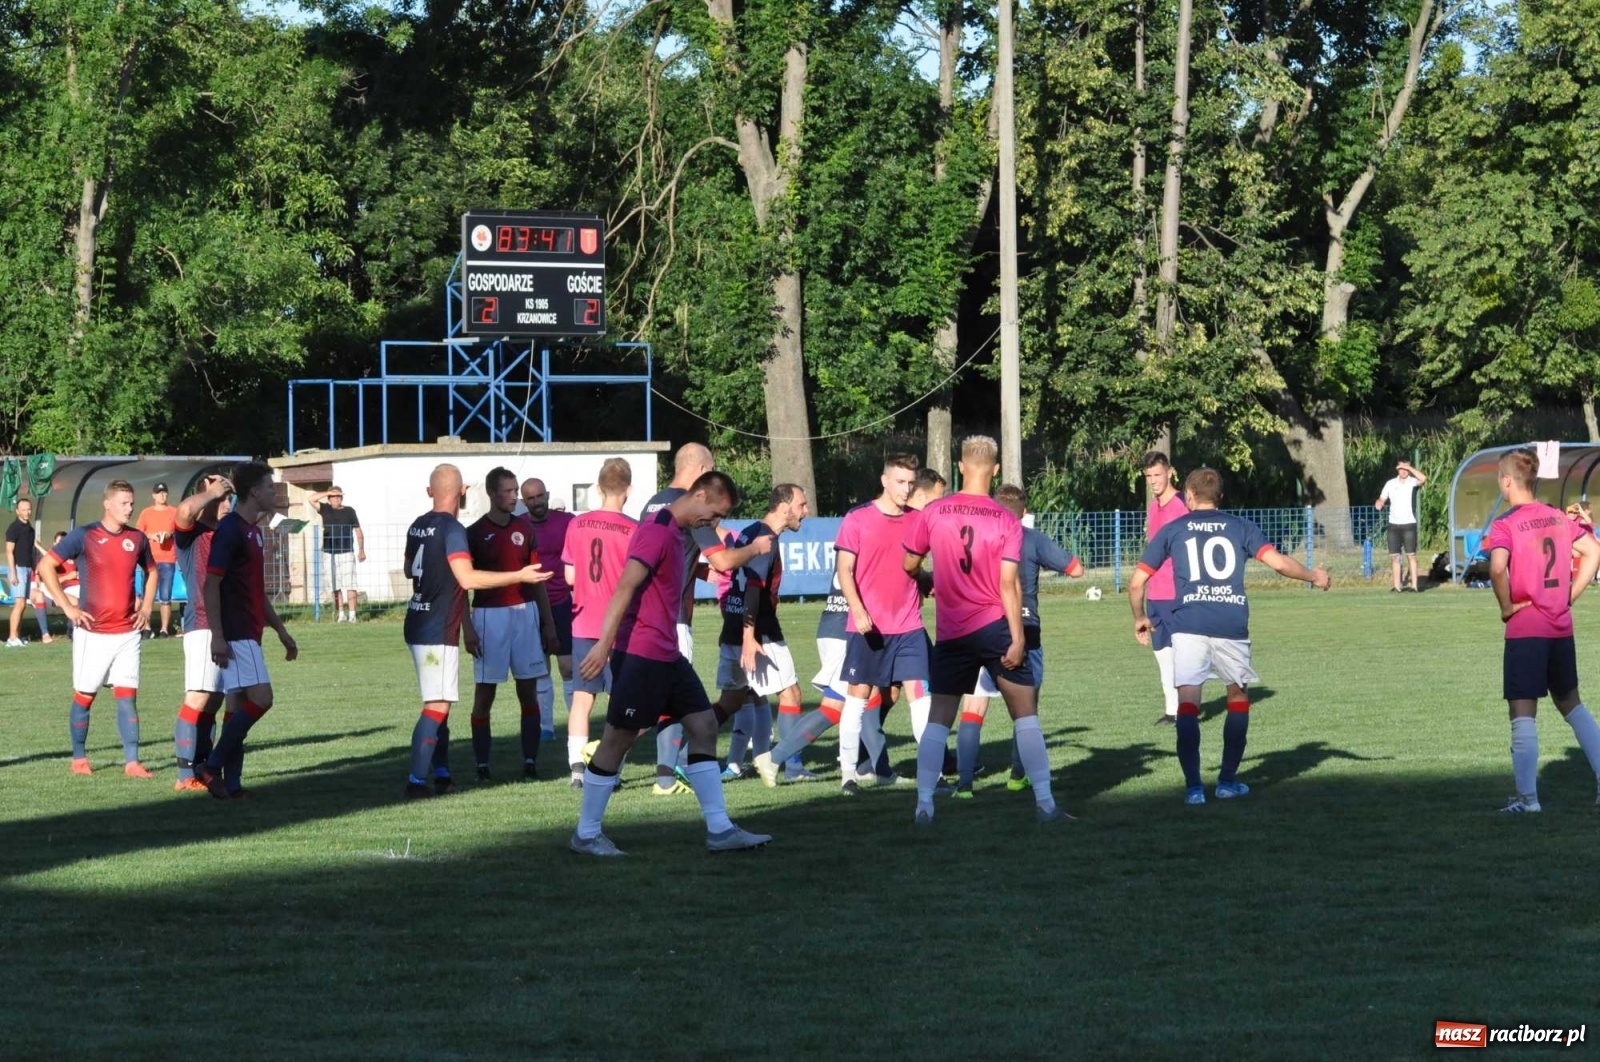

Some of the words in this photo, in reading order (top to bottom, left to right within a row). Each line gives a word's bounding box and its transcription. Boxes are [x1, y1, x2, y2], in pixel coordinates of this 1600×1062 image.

[497, 225, 572, 252] 83:41
[468, 273, 534, 292] GOSPODARZE
[567, 271, 602, 293] GOŚCIE
[481, 297, 497, 323] 2
[525, 298, 534, 309] KS
[583, 299, 597, 324] 2
[517, 312, 557, 324] KRZANOWICE
[1187, 521, 1227, 533] ŚWIĘTY
[589, 537, 604, 583] 8
[959, 525, 975, 575] 3
[1184, 535, 1237, 582] 10
[411, 544, 425, 586] 4
[1543, 537, 1559, 589] 2
[1182, 593, 1247, 606] KRZANOWICE
[1197, 585, 1209, 595] KS
[1211, 585, 1233, 596] 1905
